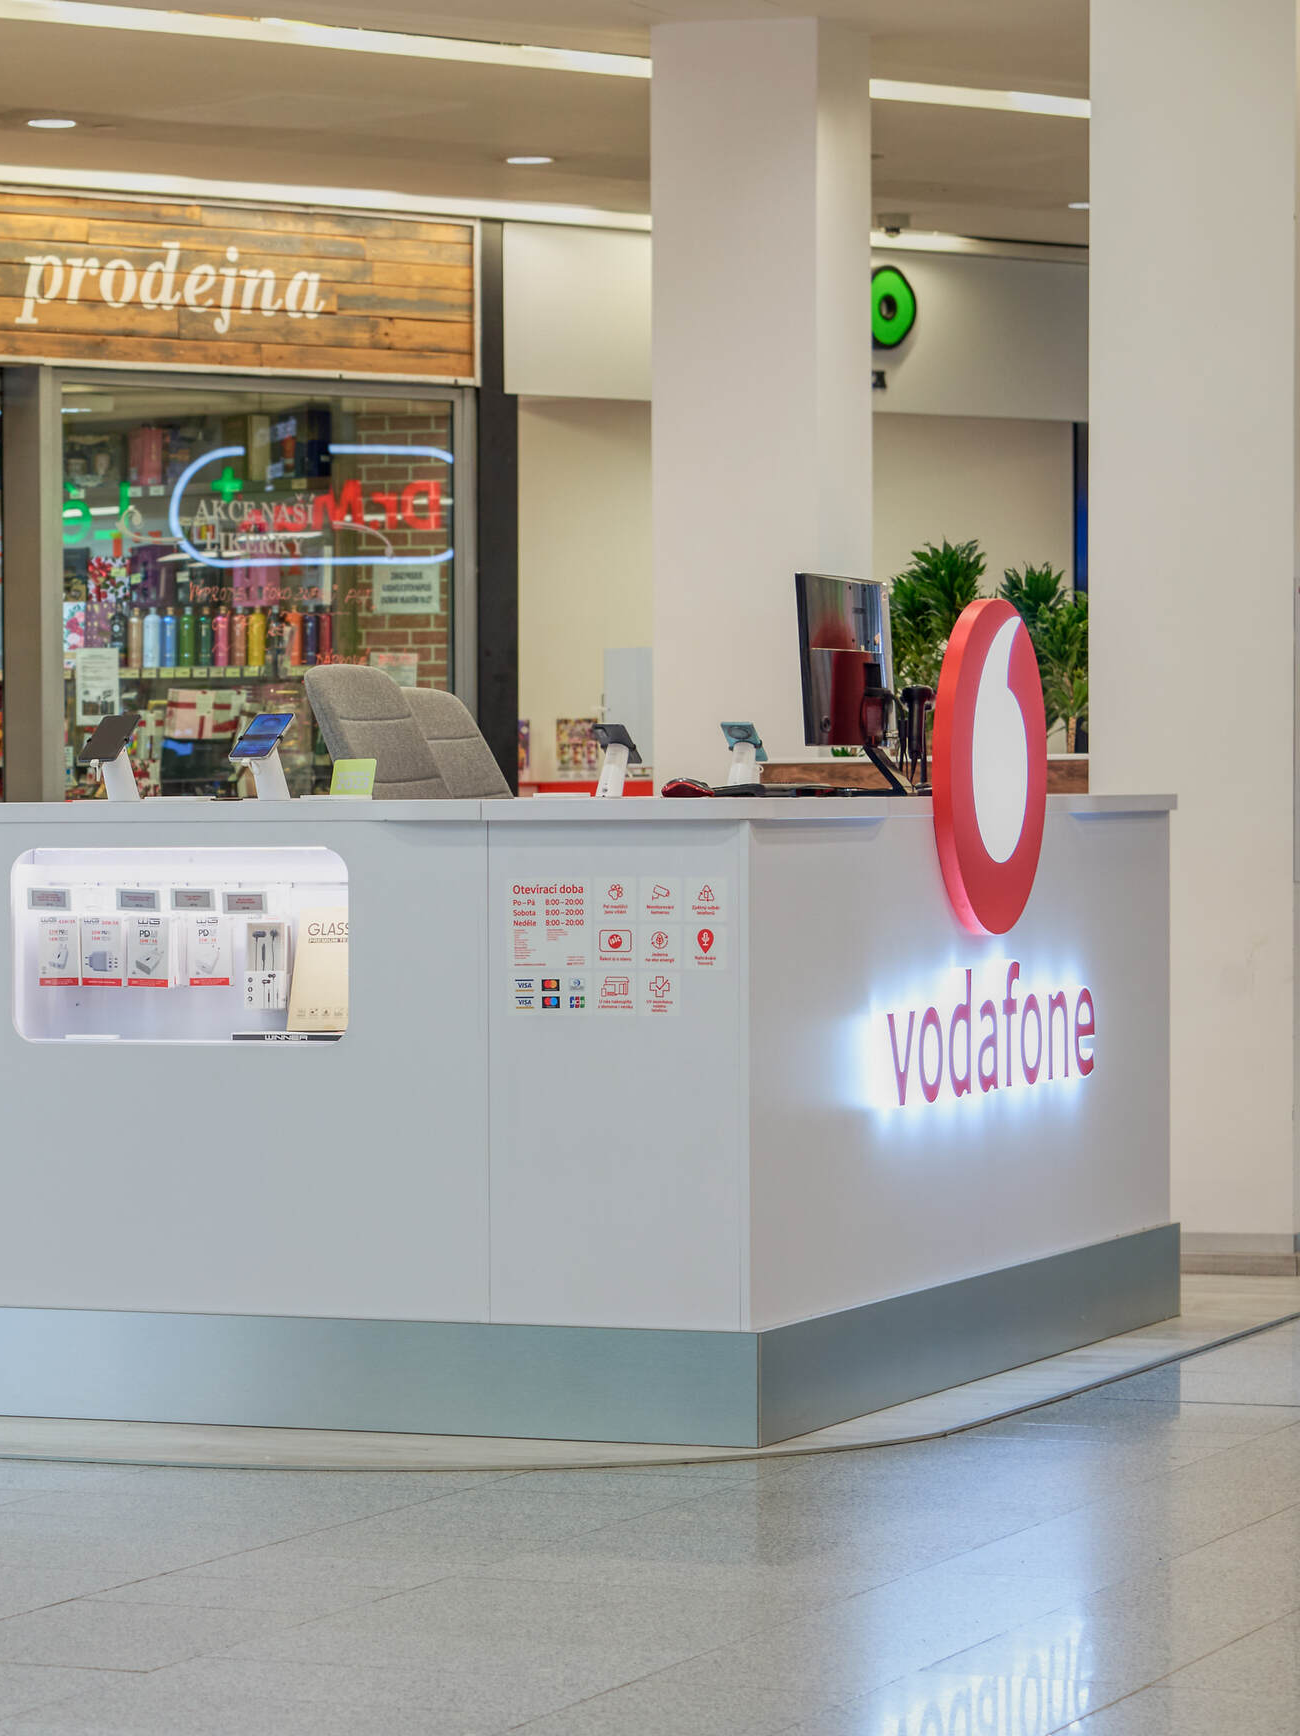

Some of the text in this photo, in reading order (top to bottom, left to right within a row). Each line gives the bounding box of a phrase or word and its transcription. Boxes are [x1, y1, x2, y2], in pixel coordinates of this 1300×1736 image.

[15, 241, 328, 334] prodejna
[196, 498, 255, 522] AKCE
[512, 884, 584, 895] Otevírací doba
[513, 909, 536, 917] Sobota
[887, 961, 1095, 1106] vodafone
